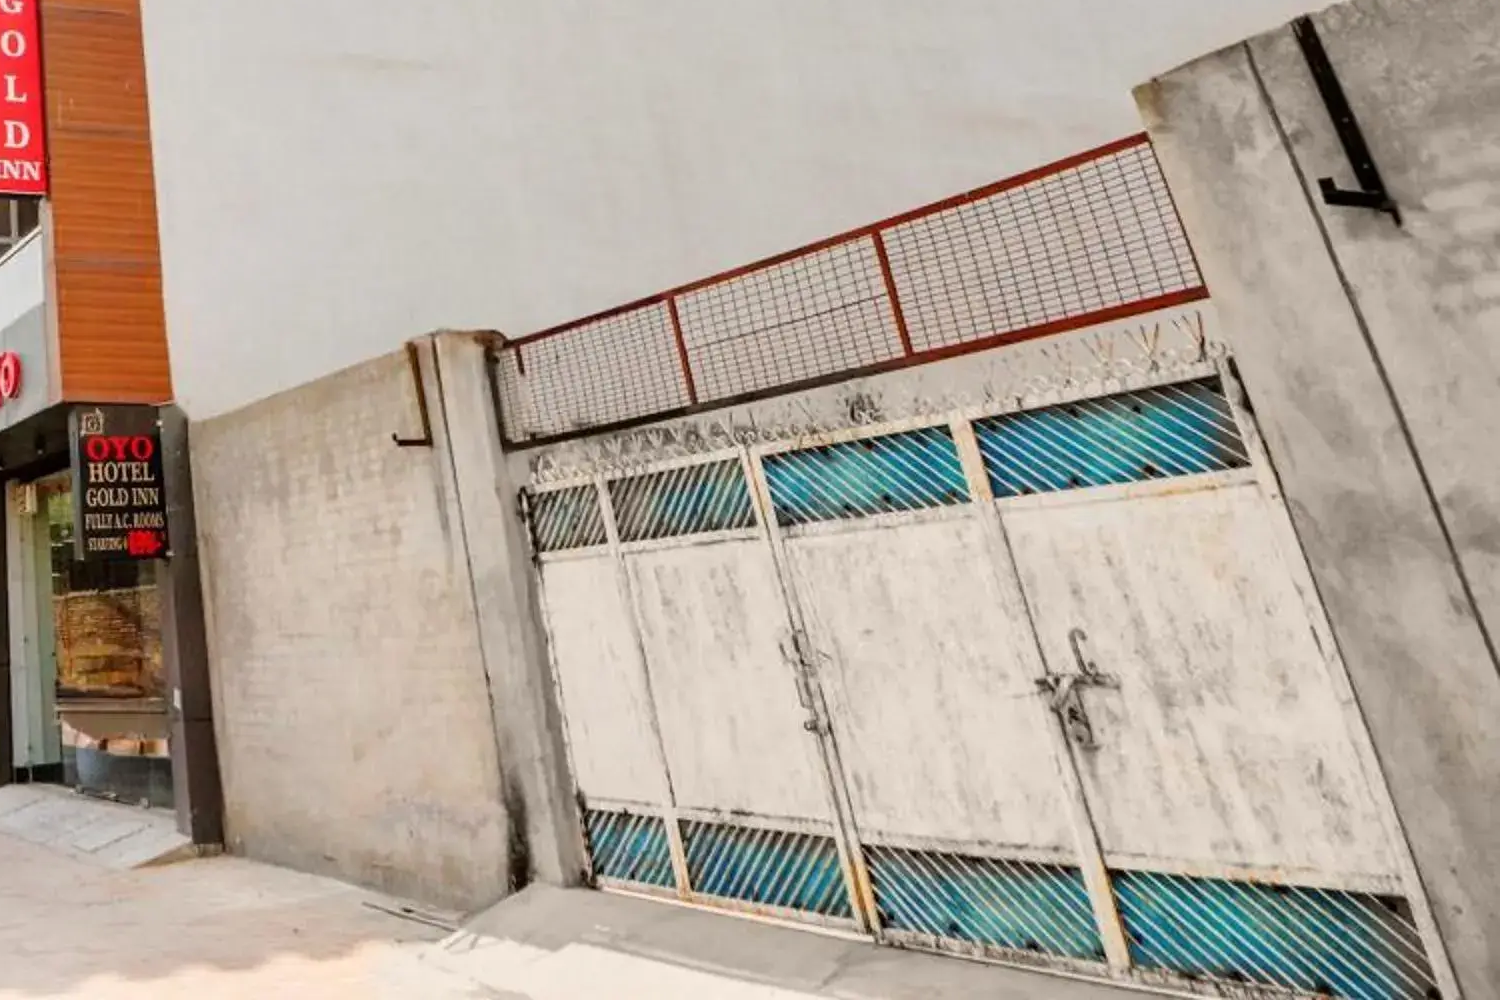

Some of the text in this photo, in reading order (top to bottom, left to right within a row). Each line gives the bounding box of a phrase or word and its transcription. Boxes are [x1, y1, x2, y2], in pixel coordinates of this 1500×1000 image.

[86, 435, 154, 461] OYO
[88, 461, 155, 483] HOTEL
[86, 487, 160, 507] GOLD INN
